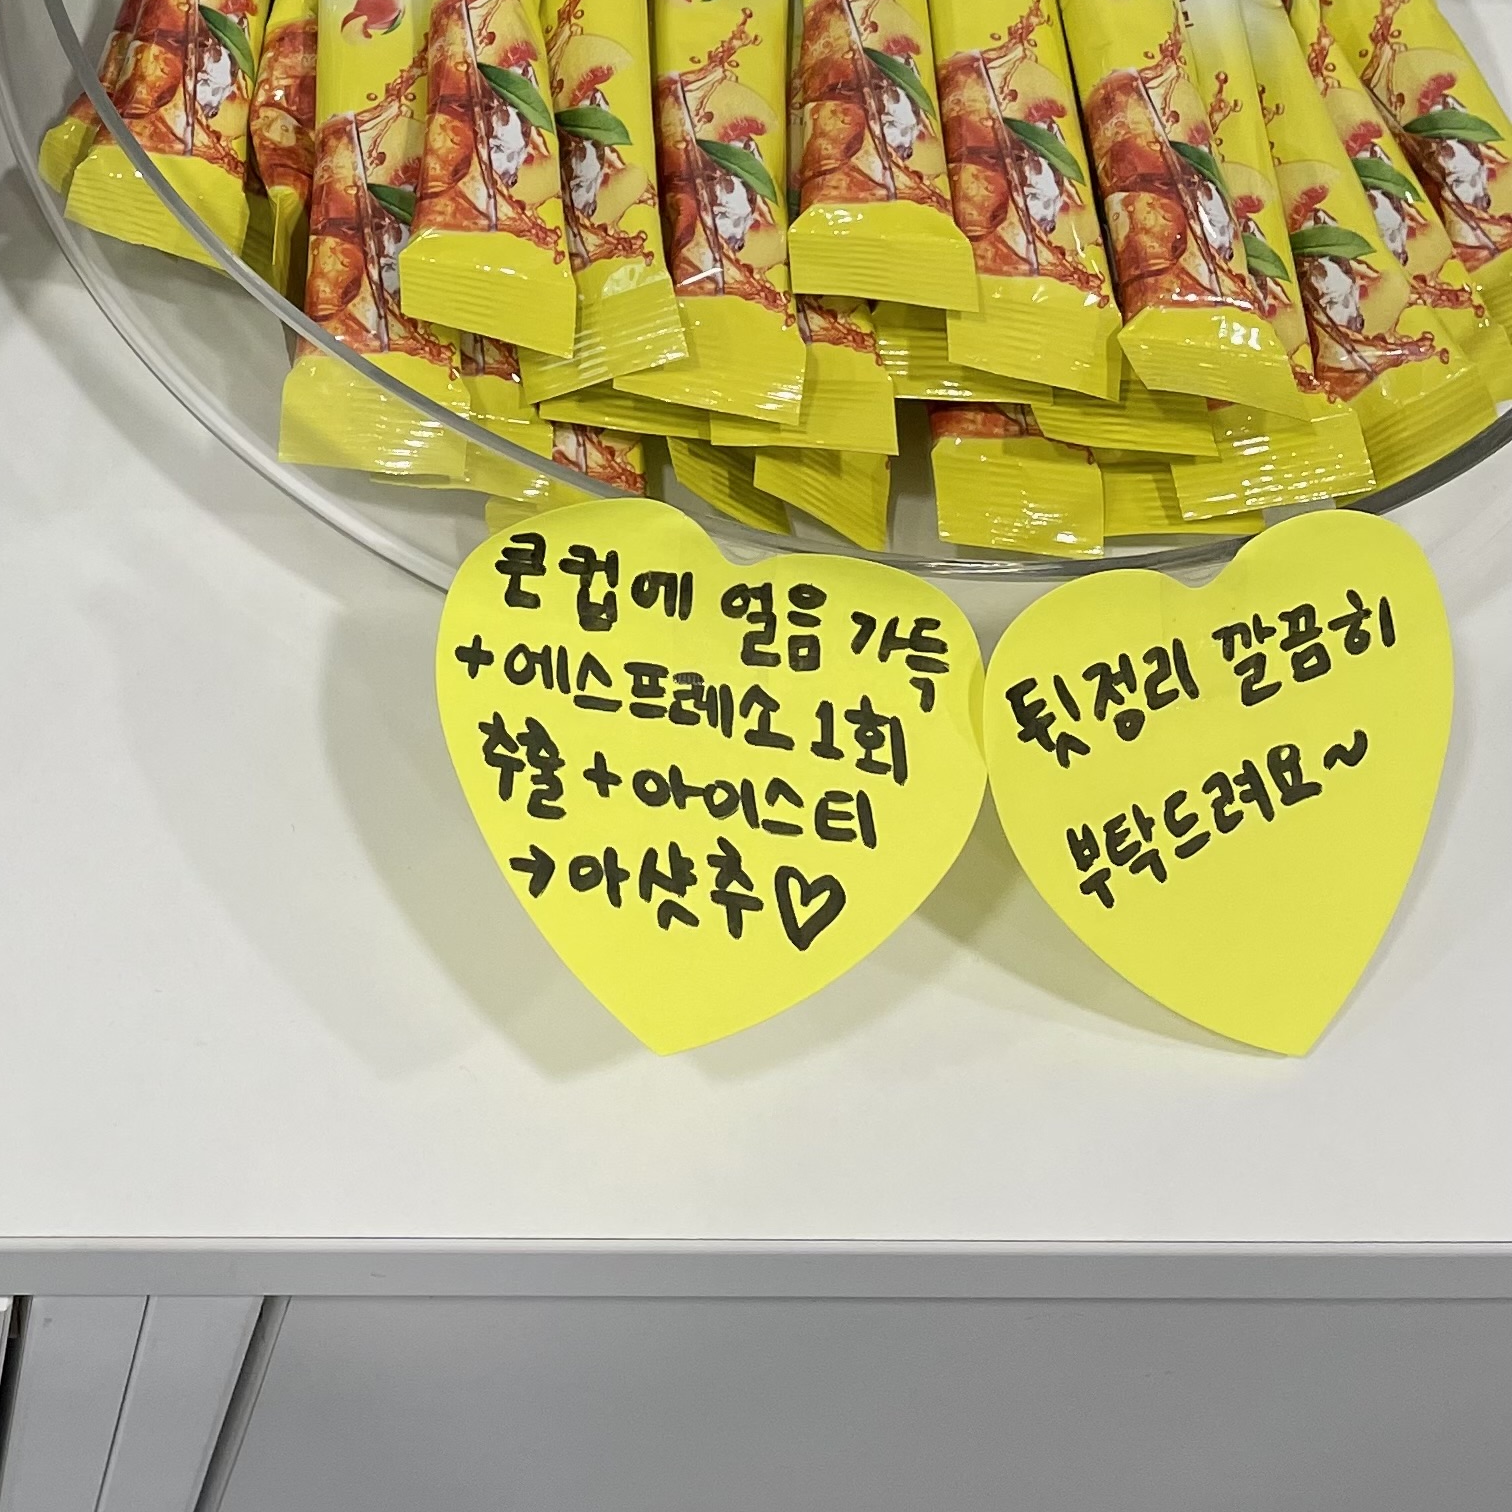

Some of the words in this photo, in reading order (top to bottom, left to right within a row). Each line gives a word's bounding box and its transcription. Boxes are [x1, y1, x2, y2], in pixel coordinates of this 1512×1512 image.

[720, 581, 827, 672] 얼음
[850, 609, 951, 713] 가득
[478, 710, 567, 821] 추출
